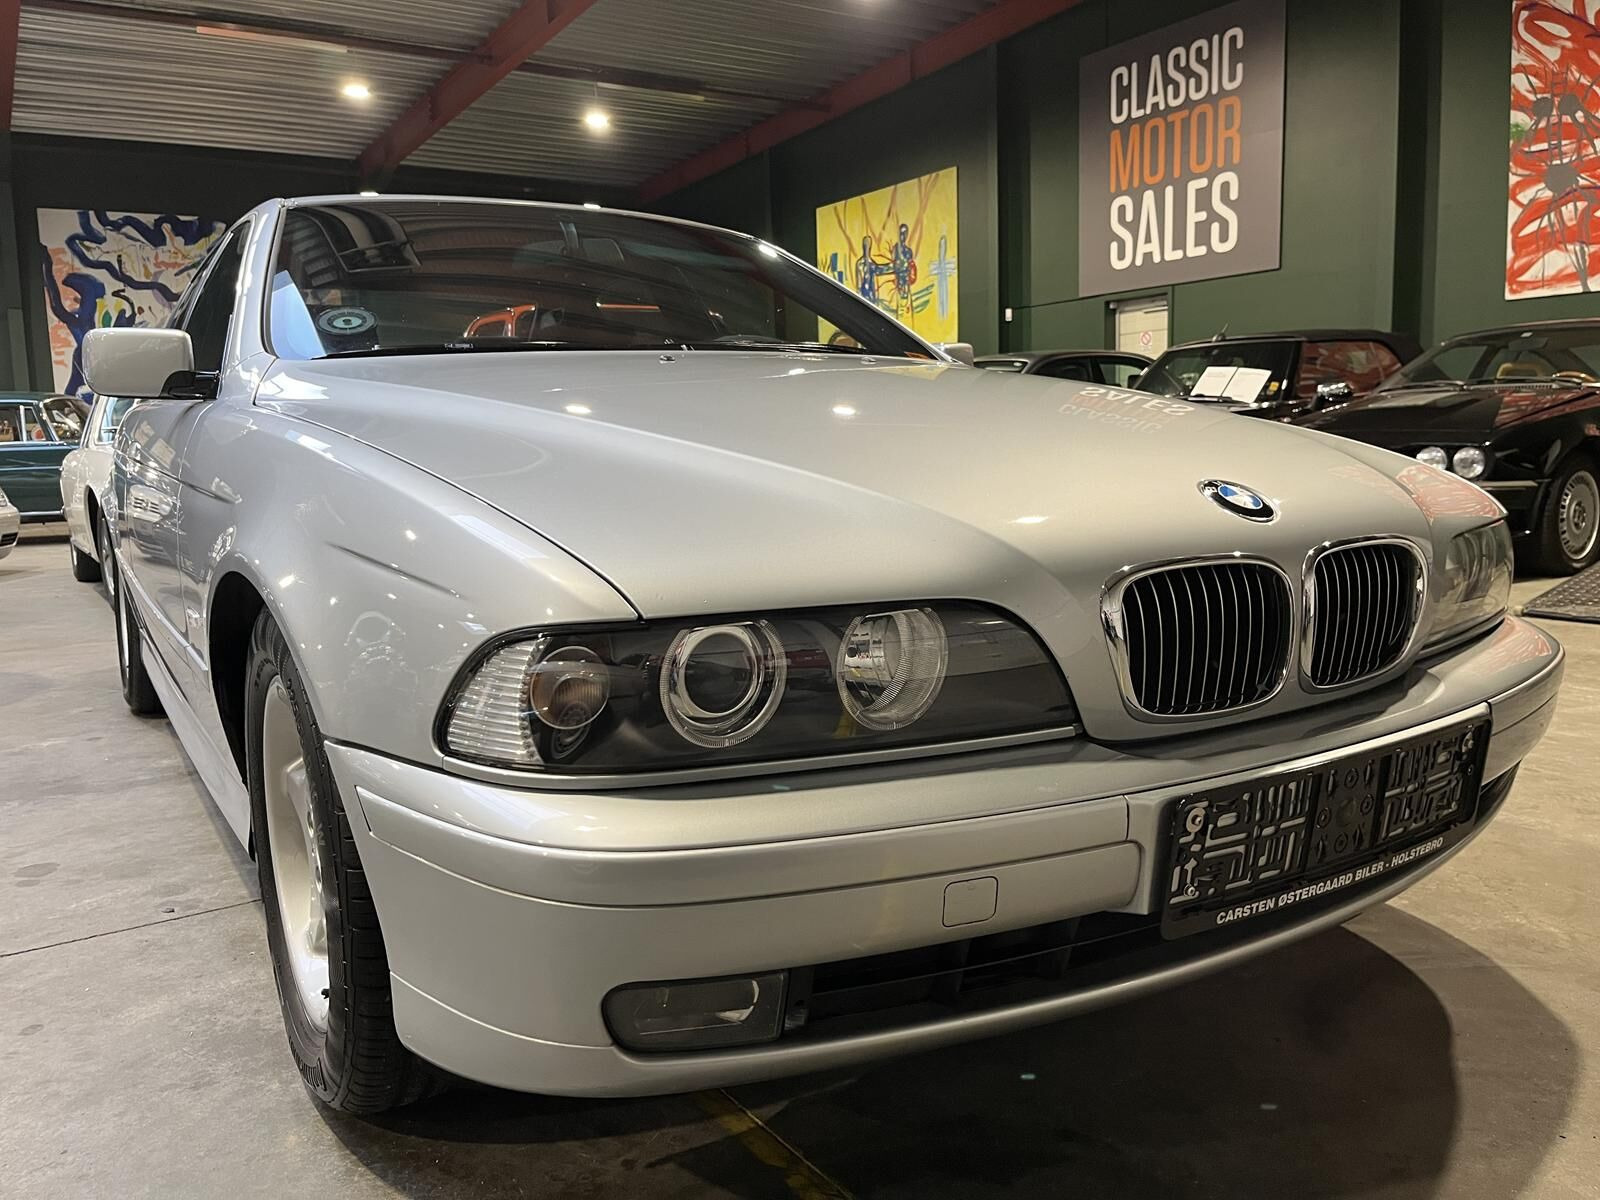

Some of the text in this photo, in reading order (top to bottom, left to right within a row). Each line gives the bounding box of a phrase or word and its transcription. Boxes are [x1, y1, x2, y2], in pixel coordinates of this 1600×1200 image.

[1110, 27, 1244, 124] CLASSIC
[1109, 95, 1242, 193] MOTOR
[1110, 171, 1239, 270] SALES
[1216, 898, 1275, 924] CARSTEN
[1278, 873, 1353, 907] ØSTERGAARD
[1355, 861, 1384, 881] BILER
[1391, 837, 1443, 867] HOLSTEBRO
